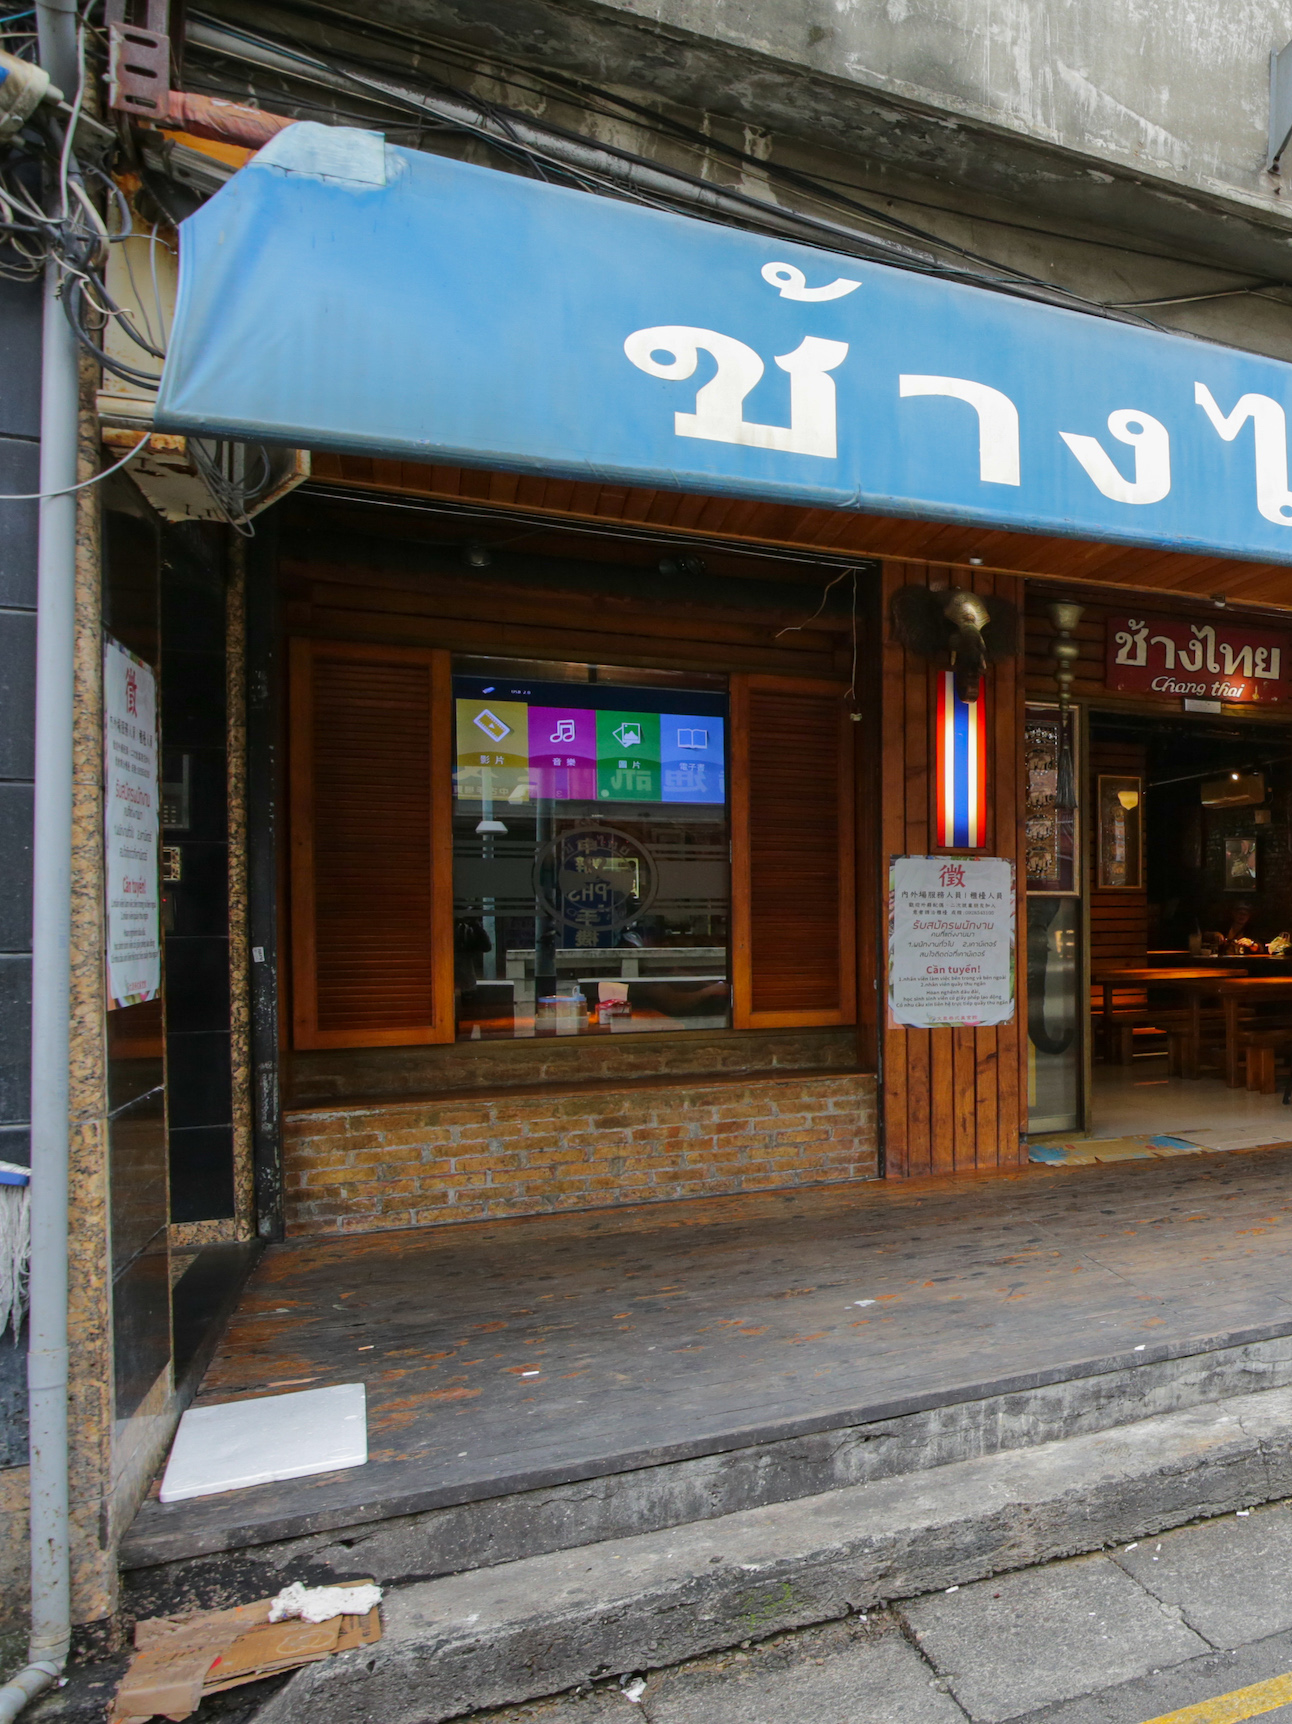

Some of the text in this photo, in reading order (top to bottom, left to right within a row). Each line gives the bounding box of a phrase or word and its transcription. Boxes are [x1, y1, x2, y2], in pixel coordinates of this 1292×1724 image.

[1115, 619, 1280, 680] ช้างไทย
[1151, 677, 1244, 698] Chang thai
[939, 864, 966, 888] 徵
